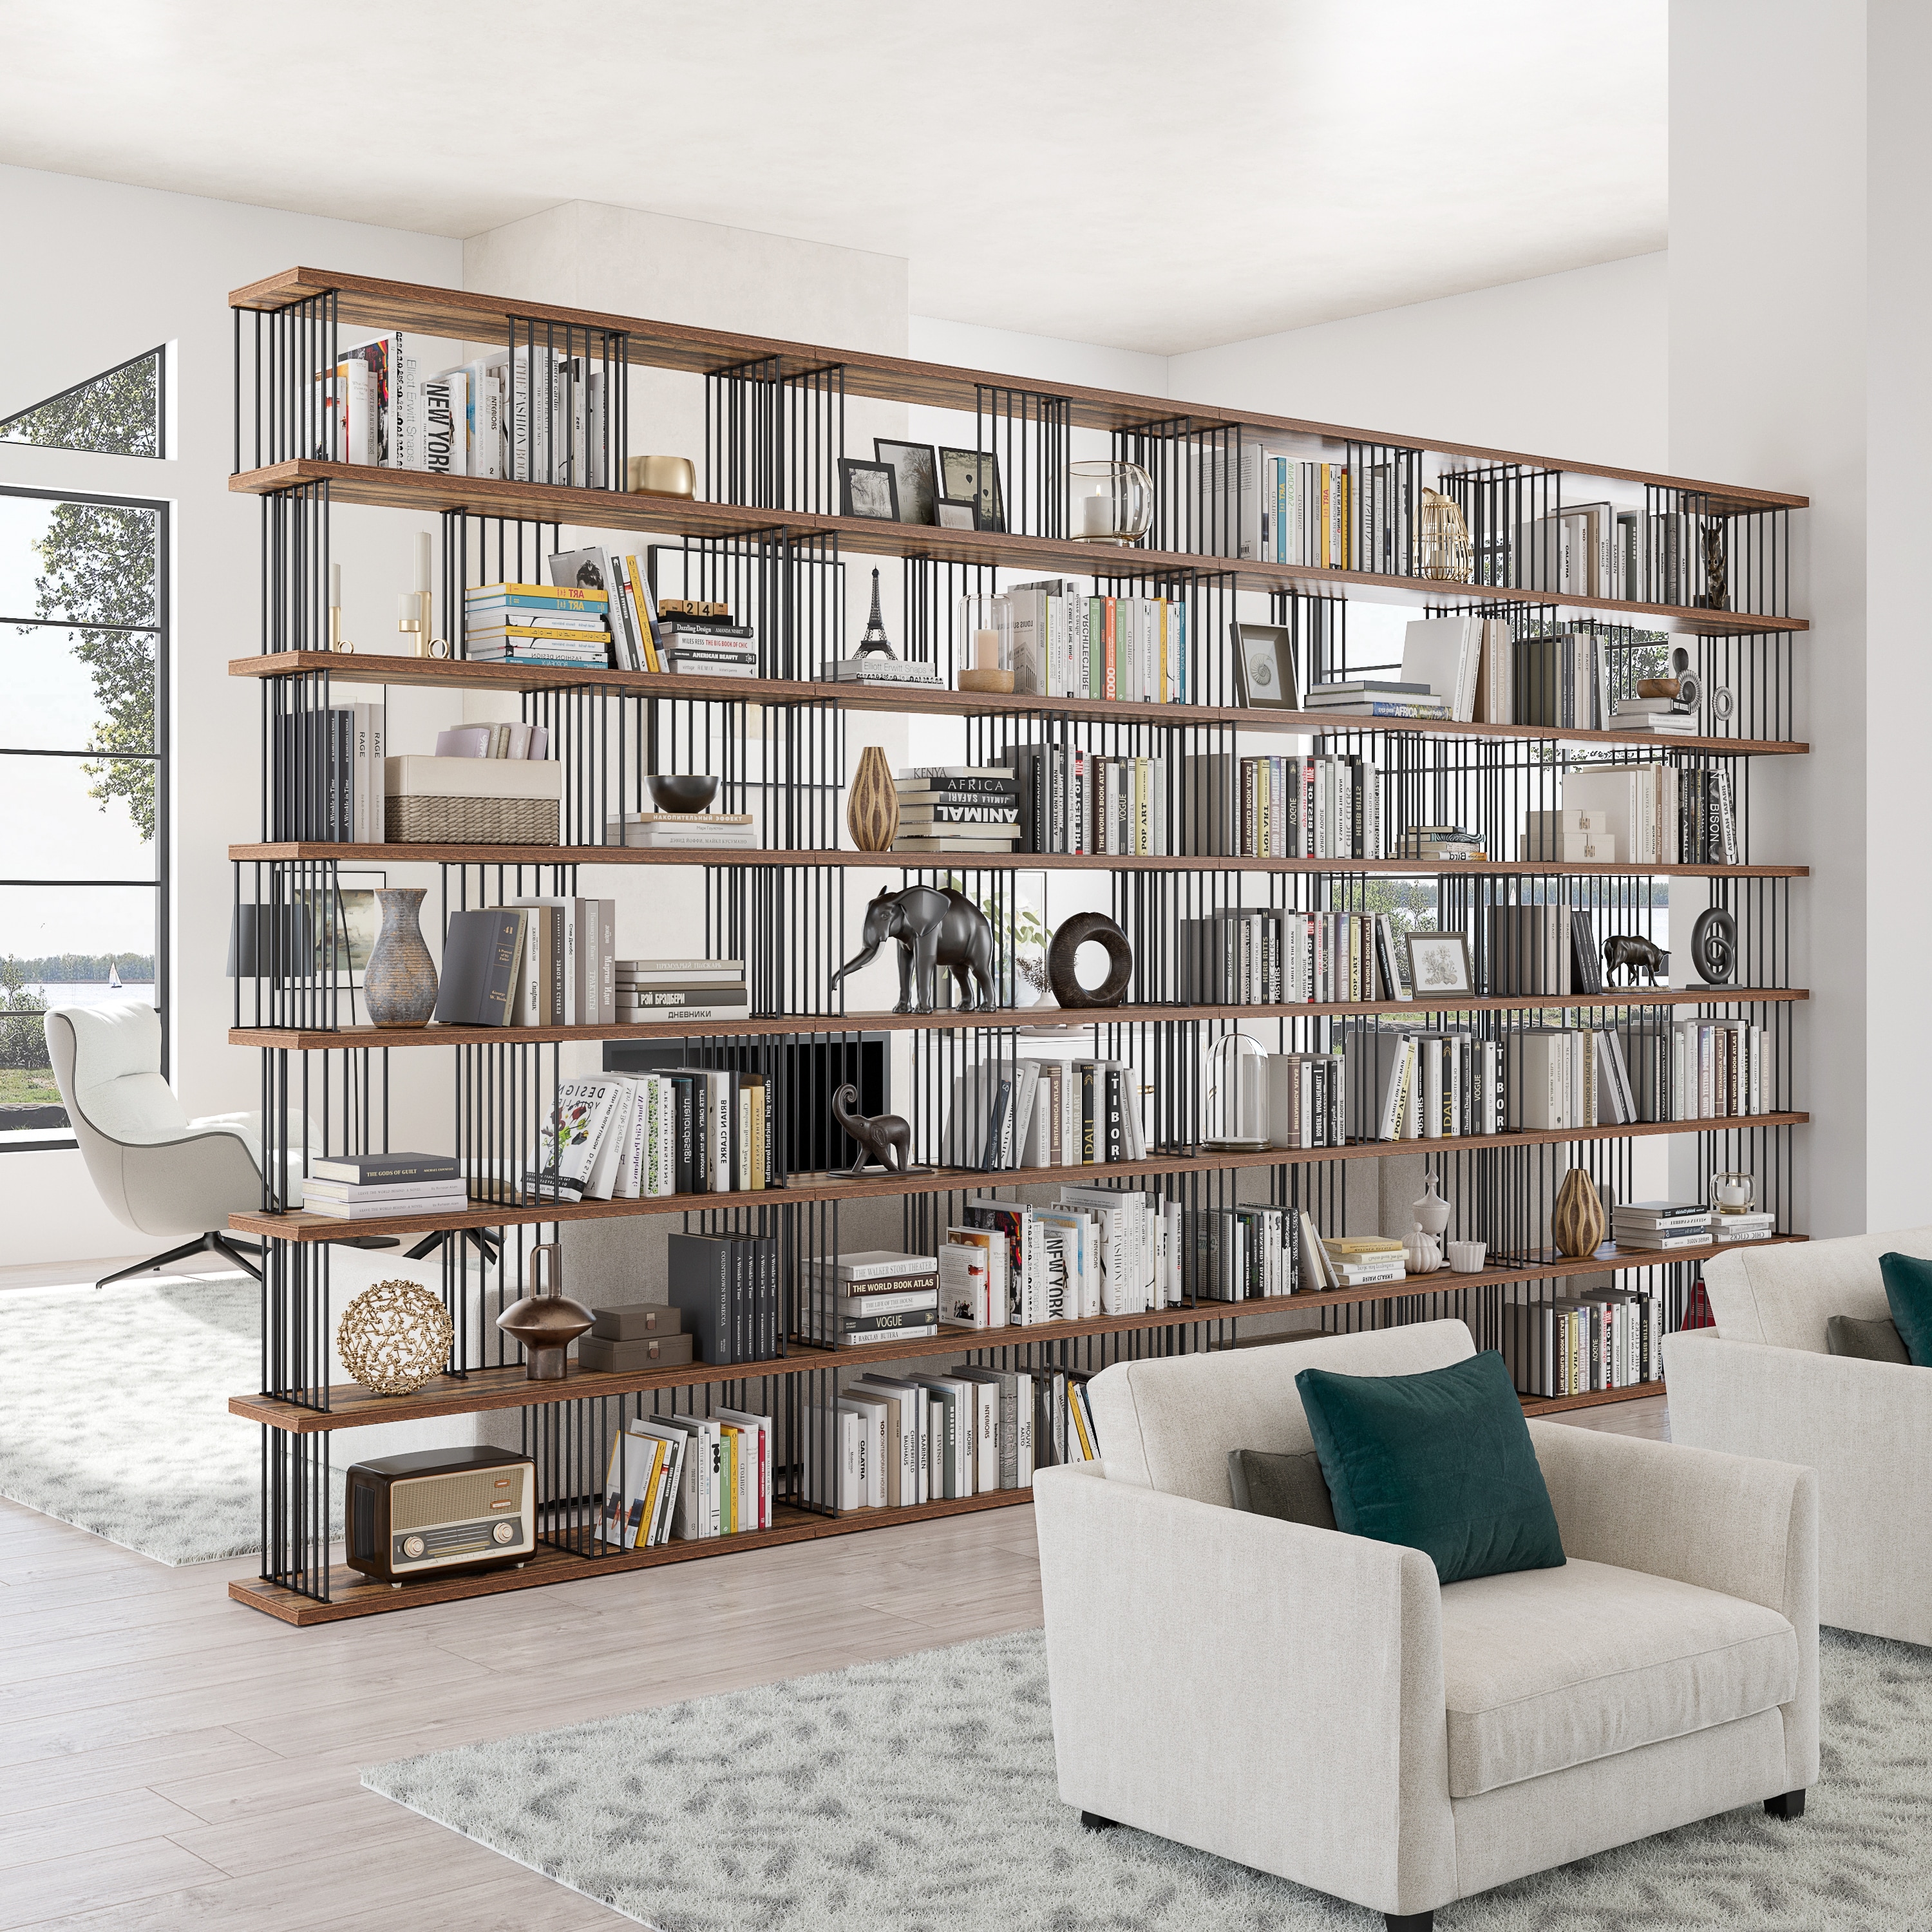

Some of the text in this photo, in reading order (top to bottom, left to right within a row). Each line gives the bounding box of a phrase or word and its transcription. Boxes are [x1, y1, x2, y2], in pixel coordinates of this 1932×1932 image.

[406, 359, 417, 462] Elliott Erwitt Snaps
[426, 384, 450, 426] NEW
[687, 602, 710, 616] 2 4
[676, 624, 696, 633] Dazzling
[696, 625, 712, 634] Design
[864, 661, 927, 674] Elliott Erwitt Snaps
[914, 767, 947, 779] KENYA
[948, 779, 1004, 791] AFRICA
[937, 806, 1019, 823] ANIMAL
[1710, 804, 1719, 842] BISON
[503, 926, 513, 934] 41
[656, 961, 692, 970] ПРЕМУДРЫЙ
[603, 956, 612, 1005] Мартин Иден
[641, 991, 685, 1005] РЭЙ БРЭДБЕРИ
[668, 1010, 712, 1019] ДНЕВНИКИ
[1496, 1048, 1504, 1126] TIBOR
[1763, 1078, 1768, 1086] OF
[1399, 1087, 1407, 1110] ART
[1111, 1078, 1119, 1156] TIBOR
[1443, 1092, 1452, 1127] DALI
[1001, 1130, 1010, 1159] STEVEN
[1084, 1119, 1094, 1154] DALI
[855, 1261, 932, 1278] THE WALKER STORY THEATER
[853, 1278, 934, 1293] THE WORLD BOOK ATLAS
[721, 1293, 726, 1302] TO
[1033, 1282, 1041, 1312] Snaps
[1048, 1279, 1063, 1318] YORK
[876, 1315, 902, 1328] VOGUE
[858, 1331, 899, 1342] BARCLAY BUTERA
[1005, 1394, 1014, 1465] CONCRETE
